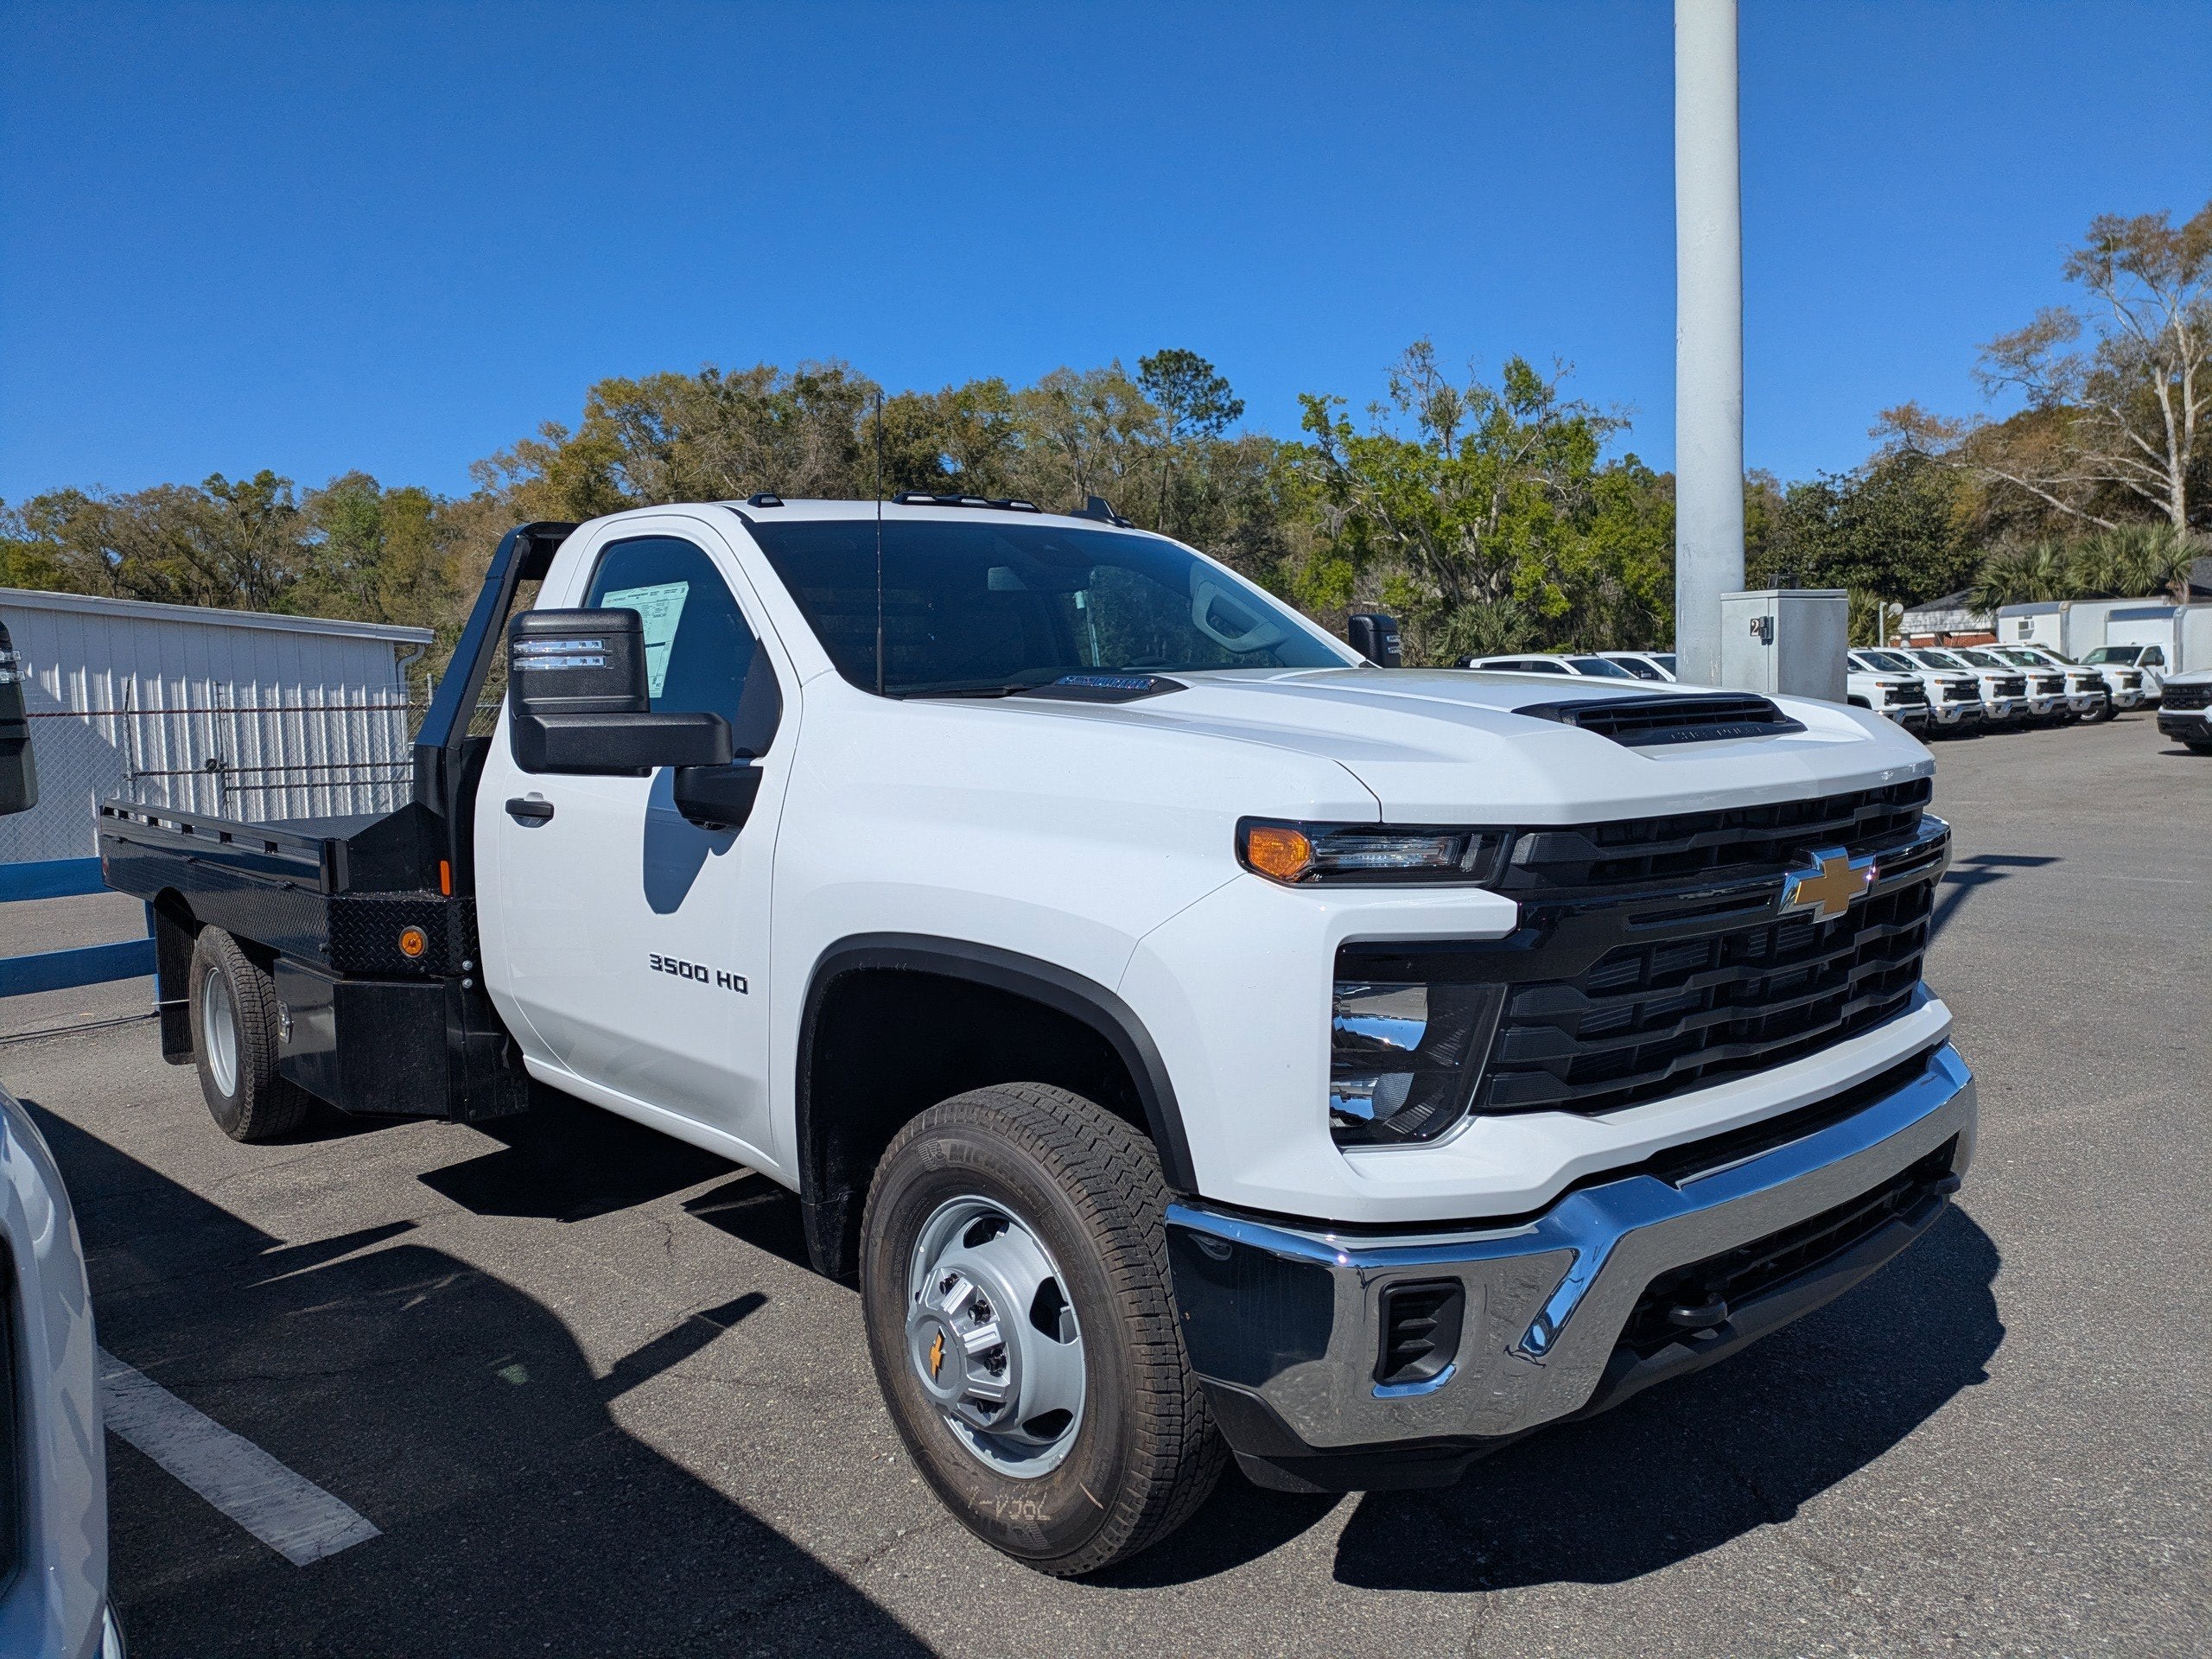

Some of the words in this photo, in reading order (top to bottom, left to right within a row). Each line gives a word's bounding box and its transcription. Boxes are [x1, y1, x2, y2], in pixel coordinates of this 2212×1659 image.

[1751, 619, 1759, 636] 2
[649, 952, 709, 983] 3500
[716, 969, 748, 995] HD
